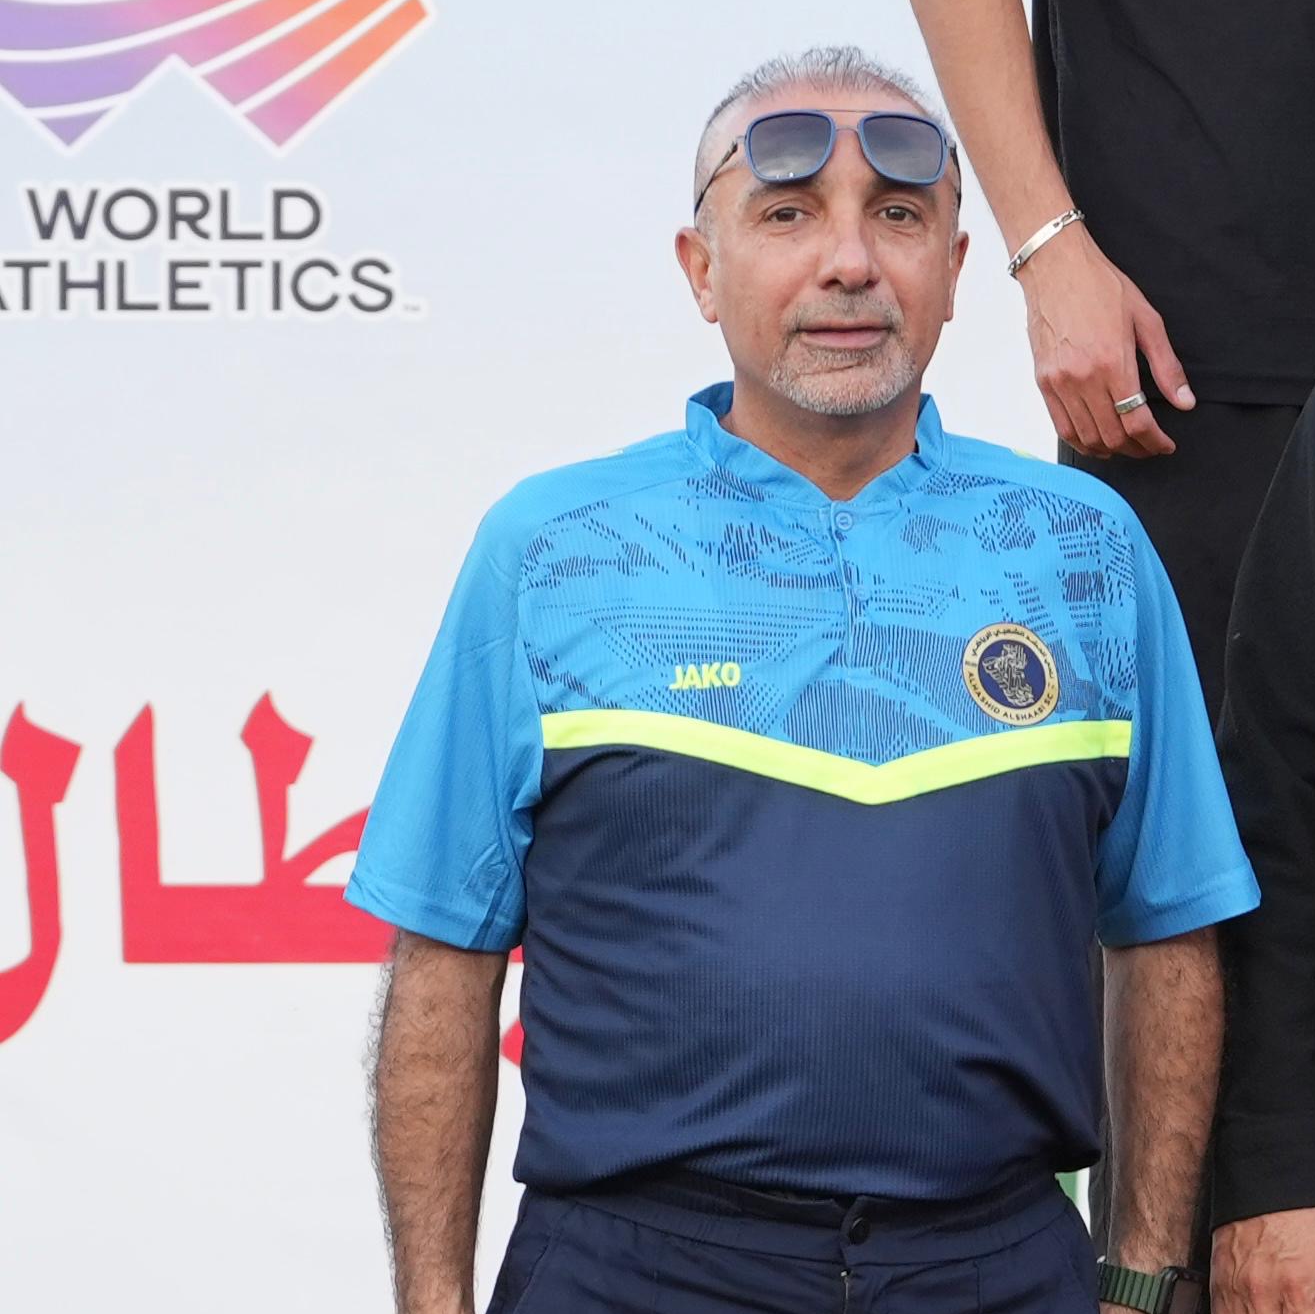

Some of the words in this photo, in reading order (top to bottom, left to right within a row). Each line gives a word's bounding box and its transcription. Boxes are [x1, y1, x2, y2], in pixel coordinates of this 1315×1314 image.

[27, 188, 323, 242] WORLD
[0, 258, 396, 312] THLETICS
[669, 661, 741, 691] JAKO
[968, 671, 1001, 714] ALHASHID
[1003, 704, 1046, 721] ALSHAABI
